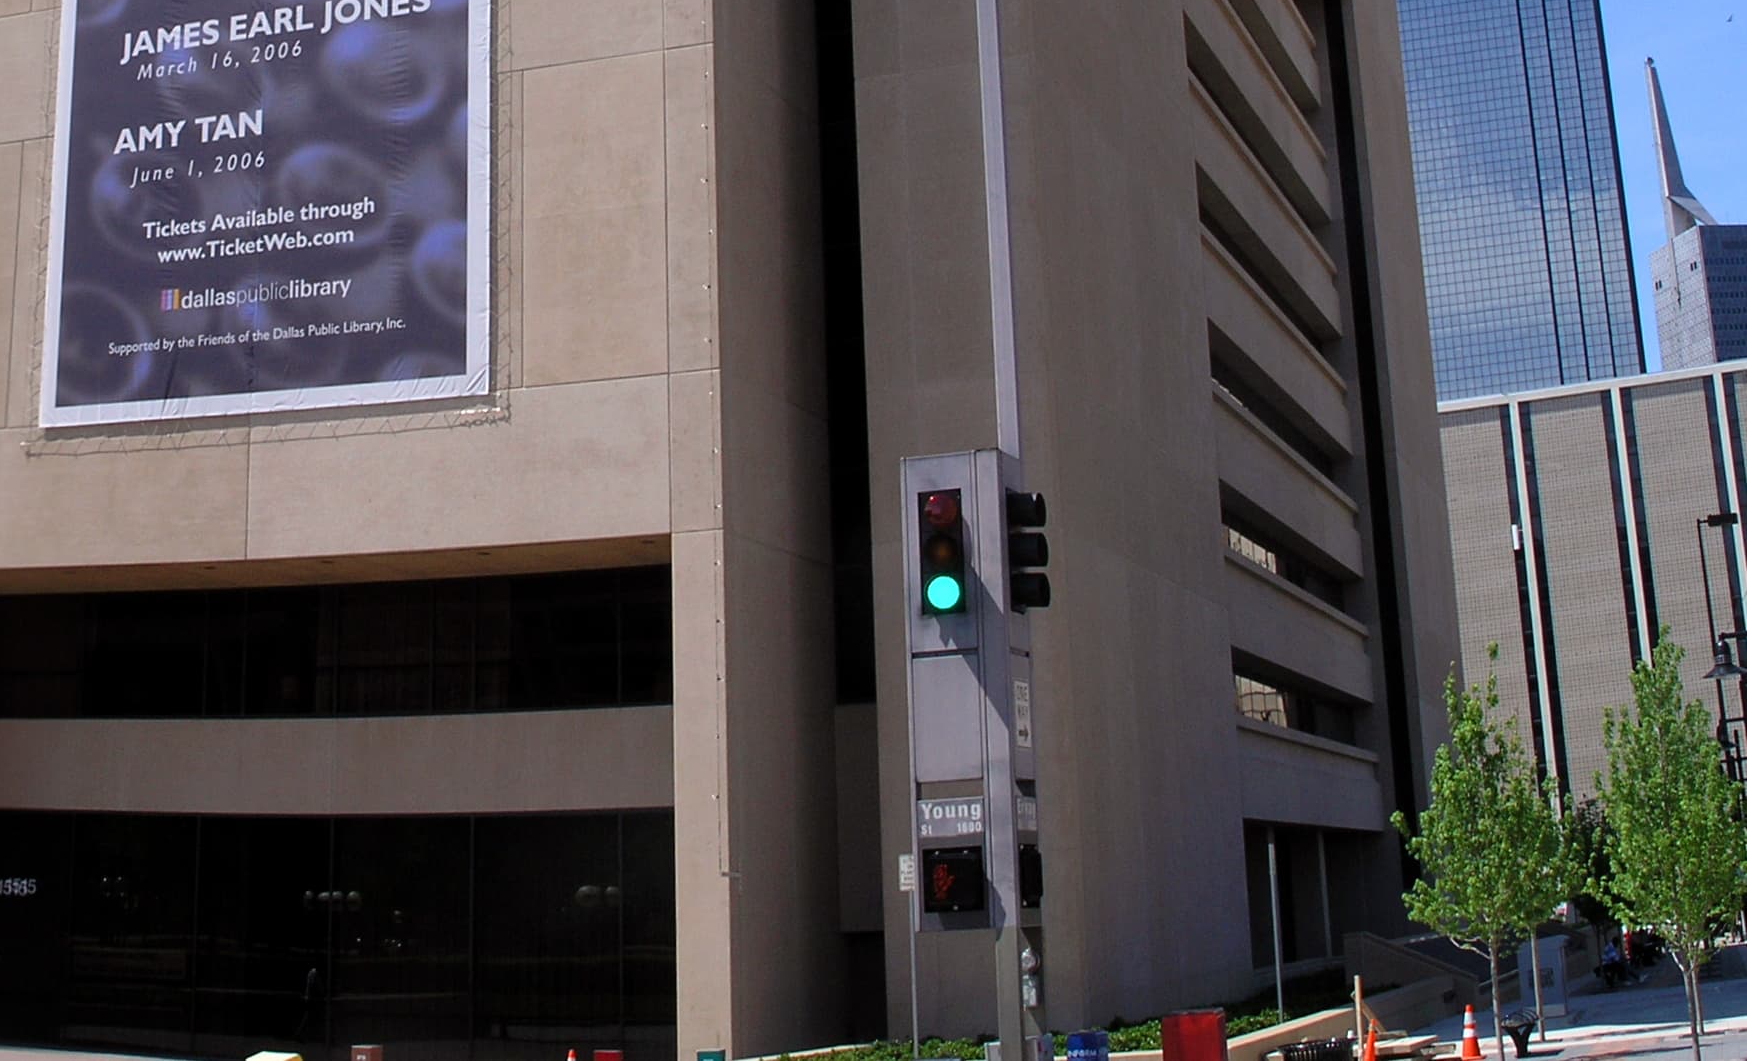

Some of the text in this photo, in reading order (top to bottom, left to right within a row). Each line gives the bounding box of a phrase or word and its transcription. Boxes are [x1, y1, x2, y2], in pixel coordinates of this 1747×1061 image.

[121, 19, 219, 65] JAMES
[230, 5, 314, 42] EARL
[137, 40, 303, 81] March 16, 2006
[112, 109, 263, 156] AMY TAN
[130, 150, 266, 188] June 1, 2006
[143, 196, 375, 240] Tickets Available through
[157, 229, 354, 263] www.TicketWeb.com
[180, 277, 352, 312] dallaspubliclibrary
[108, 317, 406, 356] Supported by the Friends of the Dallas Public Library, Inc.
[921, 803, 981, 820] Young
[921, 824, 932, 836] St
